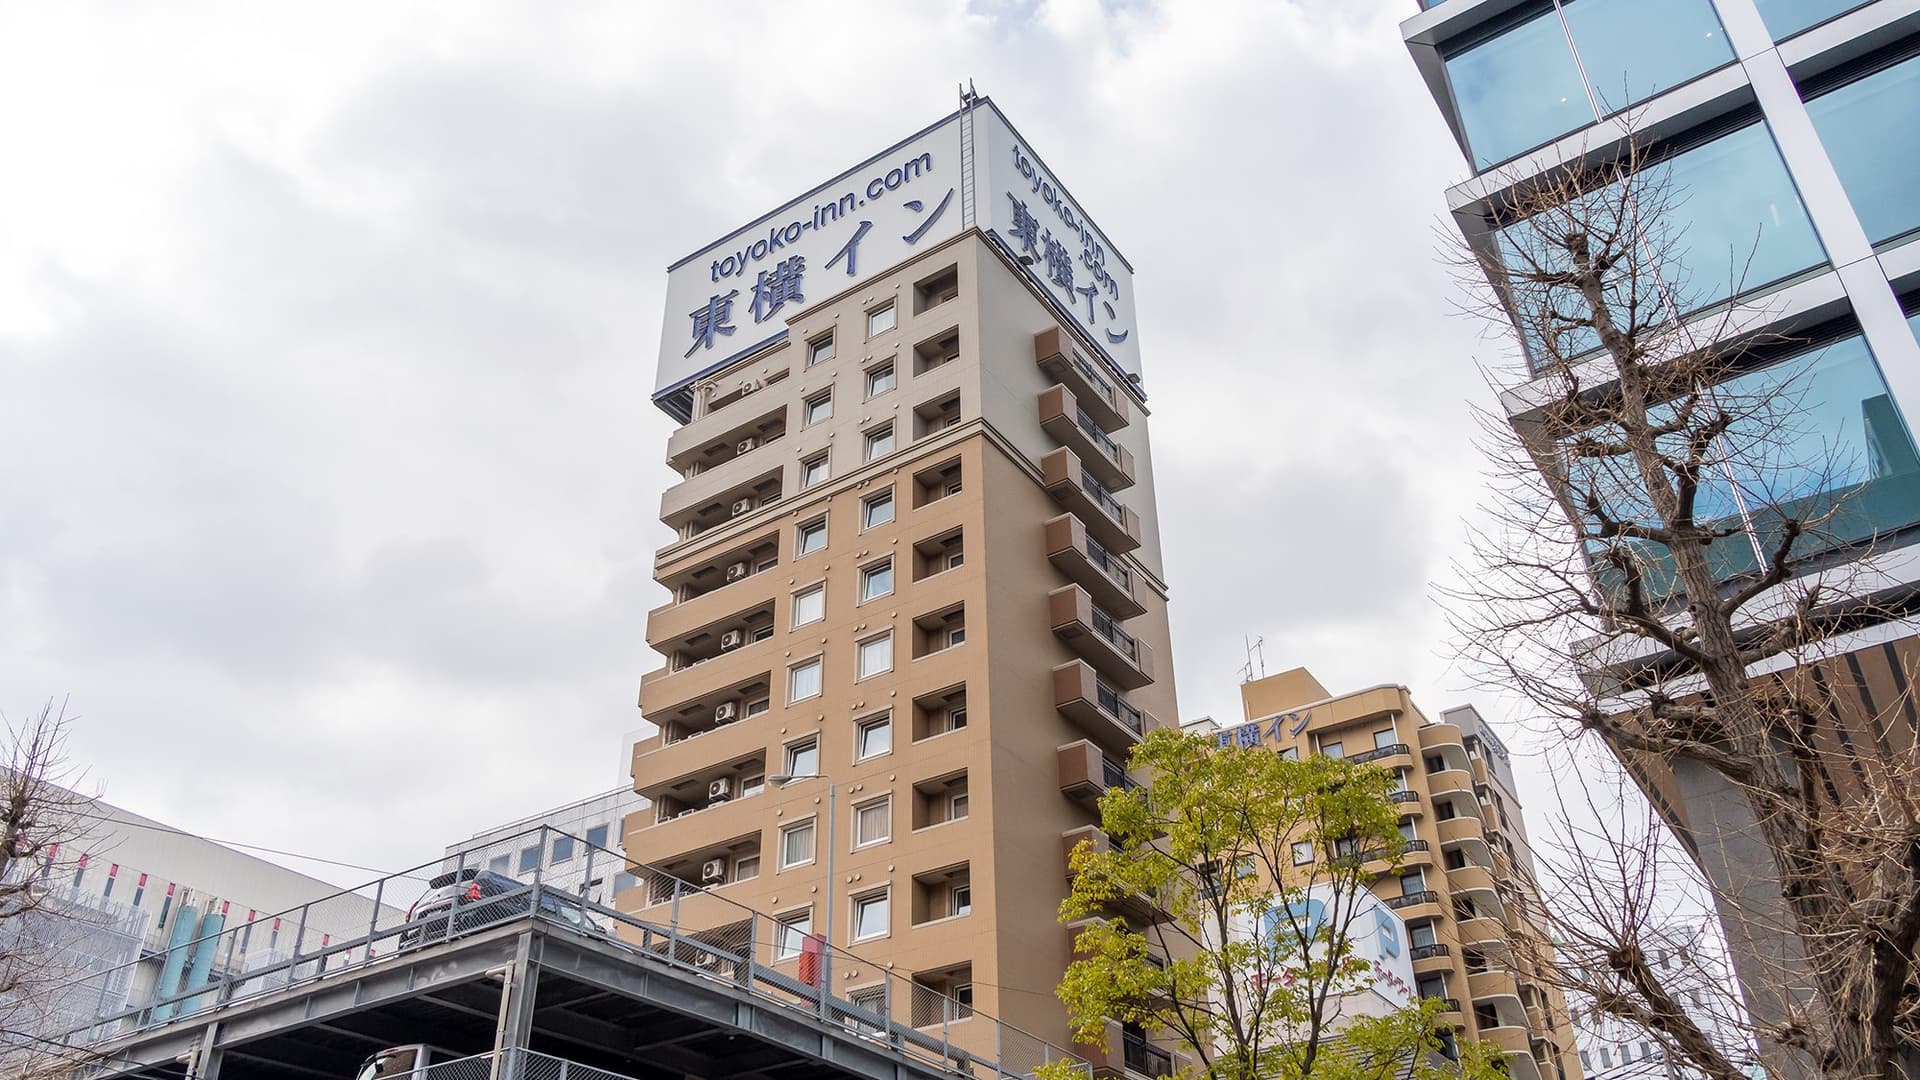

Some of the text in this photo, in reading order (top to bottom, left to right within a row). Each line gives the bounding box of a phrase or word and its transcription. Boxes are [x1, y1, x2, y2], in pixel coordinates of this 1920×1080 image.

[684, 187, 955, 359] 東横イン
[710, 152, 932, 283] toyoko-inn.com
[1006, 190, 1129, 344] 東横イン
[1374, 906, 1401, 960] P
